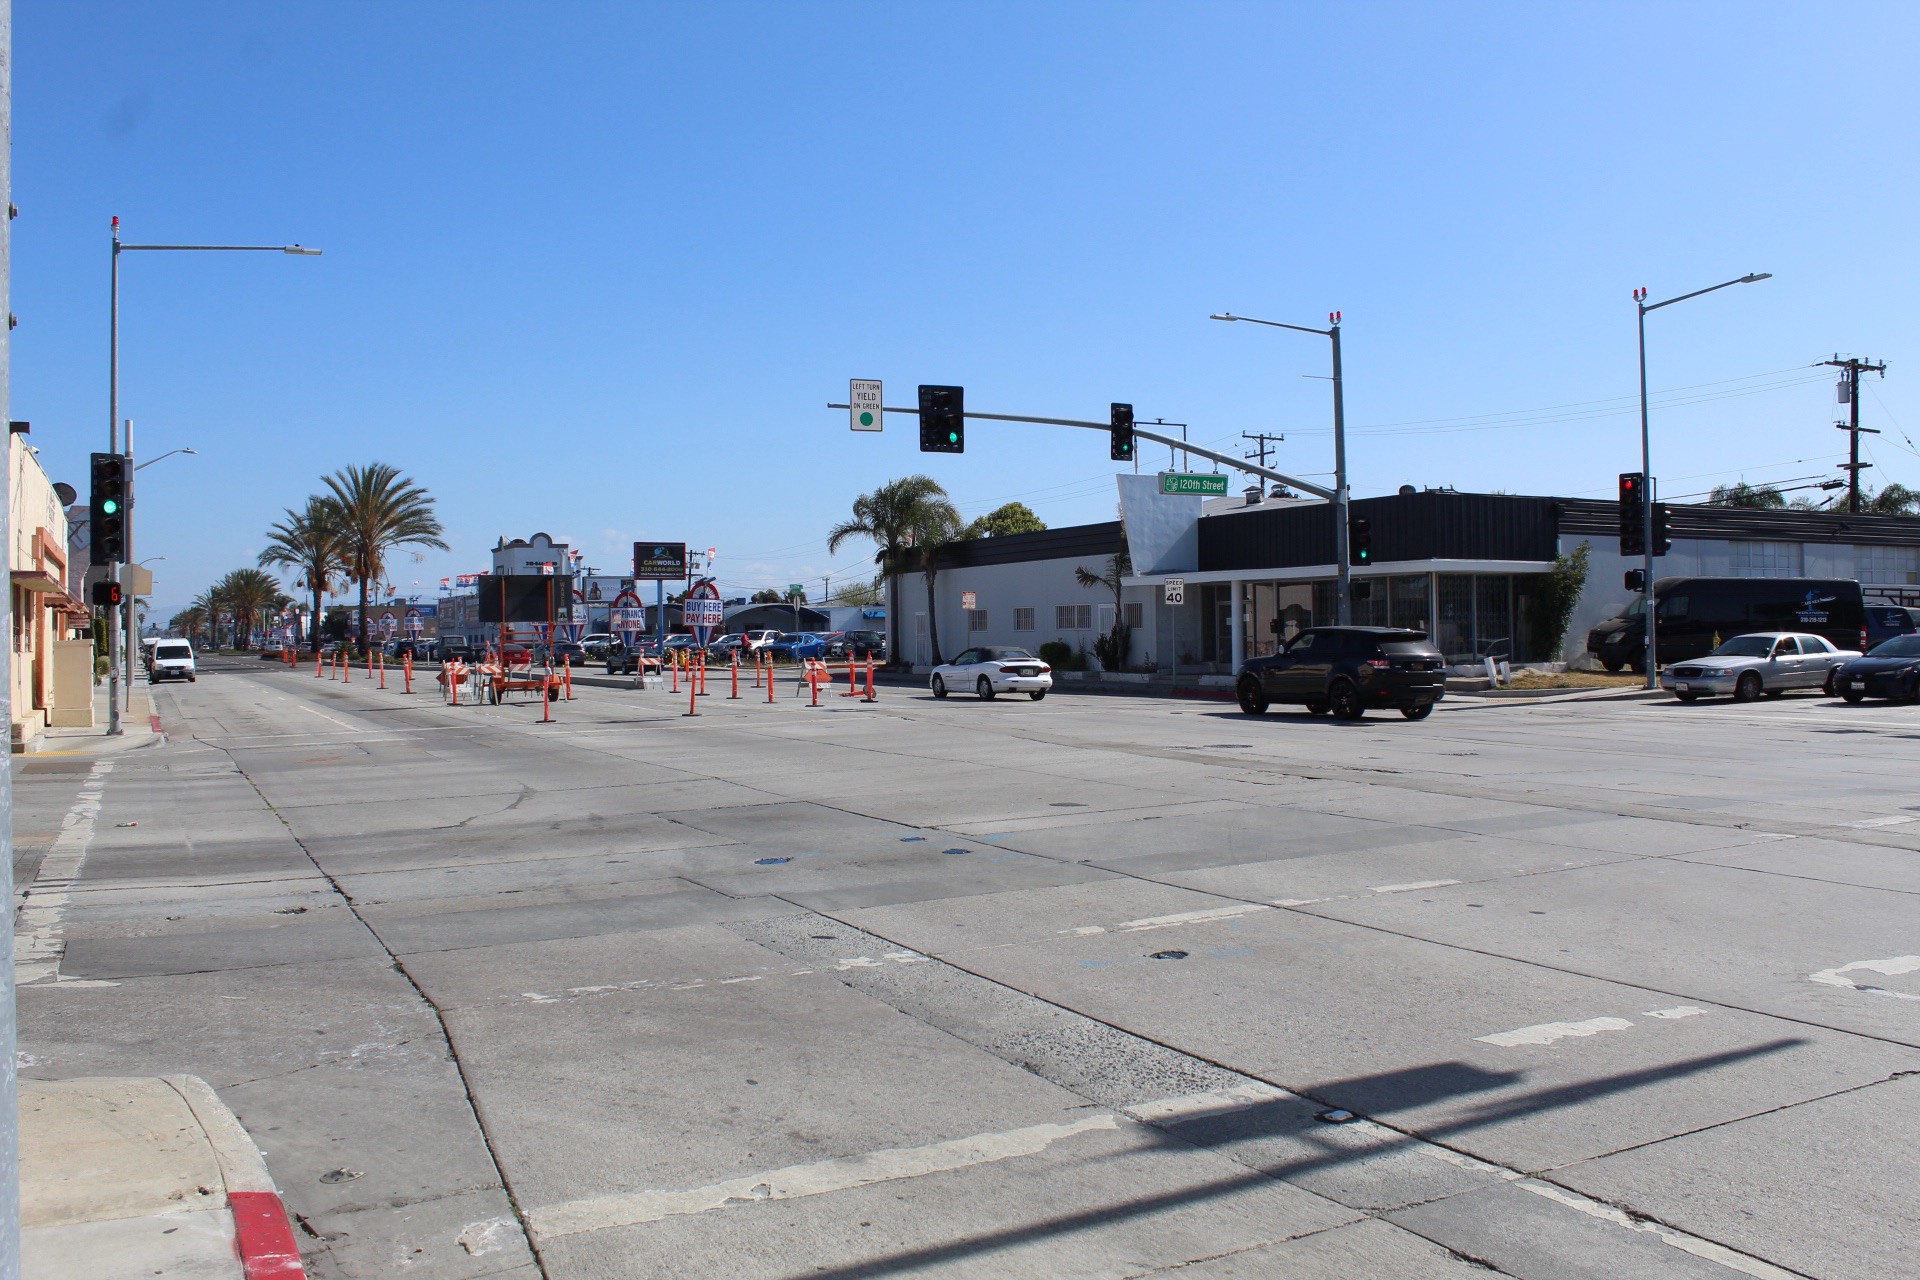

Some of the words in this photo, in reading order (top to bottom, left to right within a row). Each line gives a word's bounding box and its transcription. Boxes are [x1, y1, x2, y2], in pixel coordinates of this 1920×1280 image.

[857, 392, 876, 400] YIELD
[1180, 479, 1200, 489] 120th
[1202, 480, 1224, 490] Street
[111, 586, 118, 601] 6
[1166, 592, 1182, 603] 40
[686, 601, 702, 612] BUY
[703, 602, 722, 613] HERE
[621, 609, 644, 619] FINANCE
[685, 613, 701, 623] PAY
[702, 613, 721, 624] HERE
[617, 619, 640, 629] ANYONE
